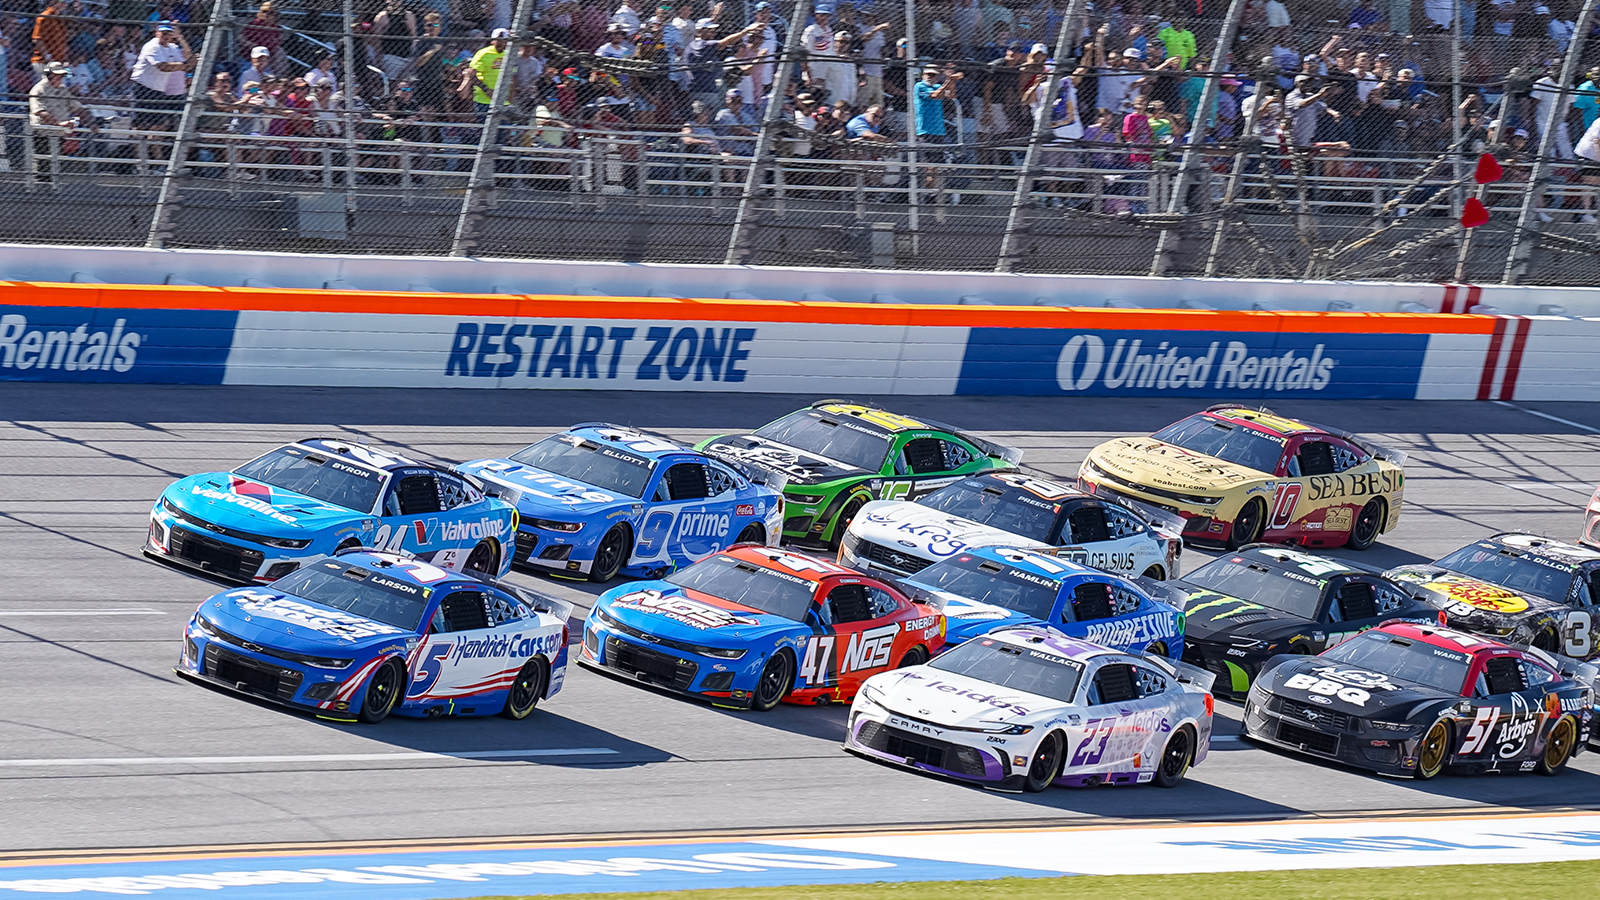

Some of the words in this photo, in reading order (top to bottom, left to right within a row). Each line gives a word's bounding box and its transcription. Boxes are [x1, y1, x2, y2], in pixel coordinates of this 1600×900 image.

[0, 314, 141, 373] Rentals
[444, 322, 637, 379] RESTART
[635, 326, 757, 383] ZONE
[1104, 338, 1220, 389] United
[1214, 341, 1335, 391] Rentals
[1251, 430, 1282, 444] DILLON
[332, 462, 370, 478] BYRON
[603, 450, 645, 466] ELLIOTT
[752, 461, 804, 484] POUCHES
[1115, 453, 1159, 466] SEAFOOD
[1162, 464, 1176, 472] TO
[1176, 469, 1201, 482] LOVE
[467, 460, 614, 504] prime
[1152, 478, 1207, 491] seabest.com
[1308, 475, 1346, 501] SEA
[1350, 469, 1401, 496] BEST
[191, 485, 298, 524] Valvoline
[1017, 495, 1053, 510] PREECE
[1270, 482, 1302, 530] 10
[441, 517, 504, 541] Valvoline
[632, 508, 677, 560] 9
[676, 506, 730, 542] prime
[758, 567, 804, 584] STENHOUSE
[1009, 569, 1053, 587] HAMLIN
[1519, 553, 1531, 561] A.
[1533, 556, 1573, 573] DILLON
[371, 576, 417, 594] LARSON
[609, 601, 664, 619] ENERGY
[664, 612, 711, 631] DRINK
[613, 589, 760, 629] NOS
[905, 616, 935, 632] ENERGY
[1086, 611, 1175, 646] PROGRESSIVE
[1565, 610, 1592, 656] 3
[800, 635, 836, 685] 47
[840, 621, 902, 674] NOS
[1029, 651, 1077, 668] WALLACE
[1433, 649, 1462, 662] WARE
[406, 641, 454, 699] 5
[926, 681, 1031, 716] leidos
[1283, 673, 1371, 707] BBQ
[890, 718, 944, 736] CAMRY
[1131, 711, 1171, 733] leidos
[1458, 706, 1501, 756] 51
[1068, 717, 1117, 767] 23
